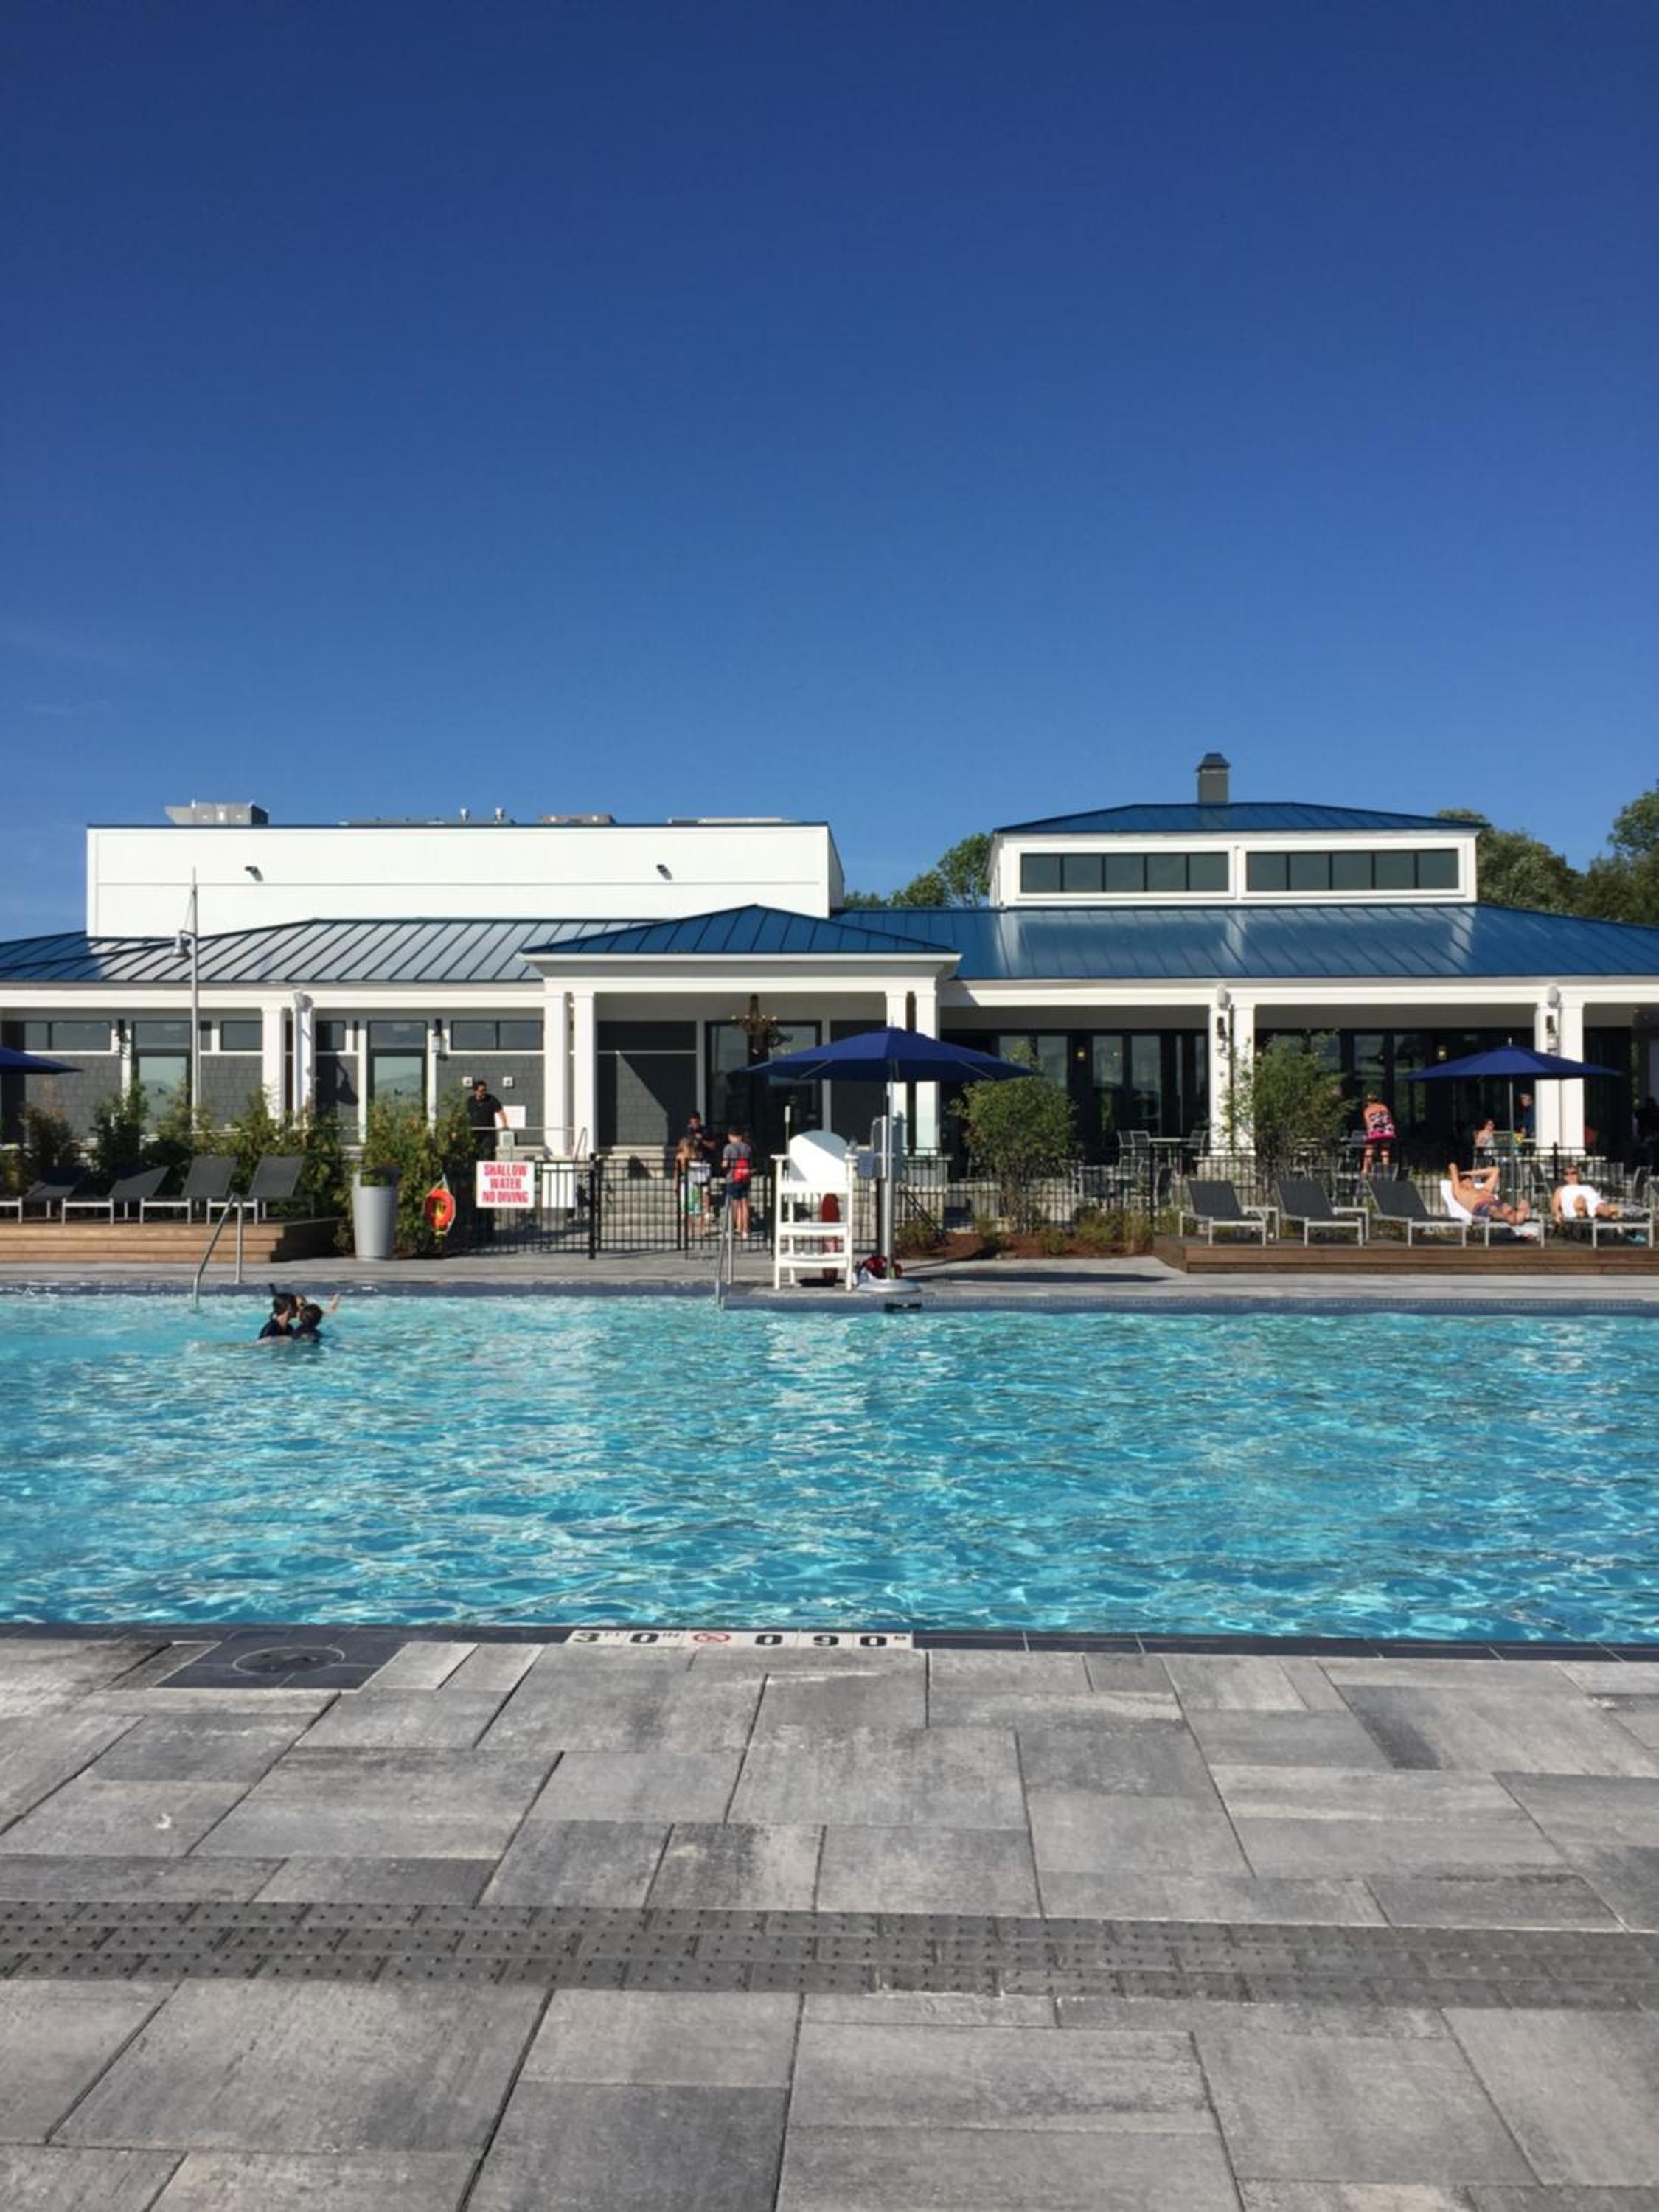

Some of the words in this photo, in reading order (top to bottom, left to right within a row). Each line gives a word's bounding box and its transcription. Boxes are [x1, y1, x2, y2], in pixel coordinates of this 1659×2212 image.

[484, 1164, 528, 1176] SHALLOW
[490, 1178, 521, 1189] WATER
[482, 1191, 495, 1203] NO
[498, 1191, 529, 1203] DIVING
[574, 1632, 601, 1644] 3
